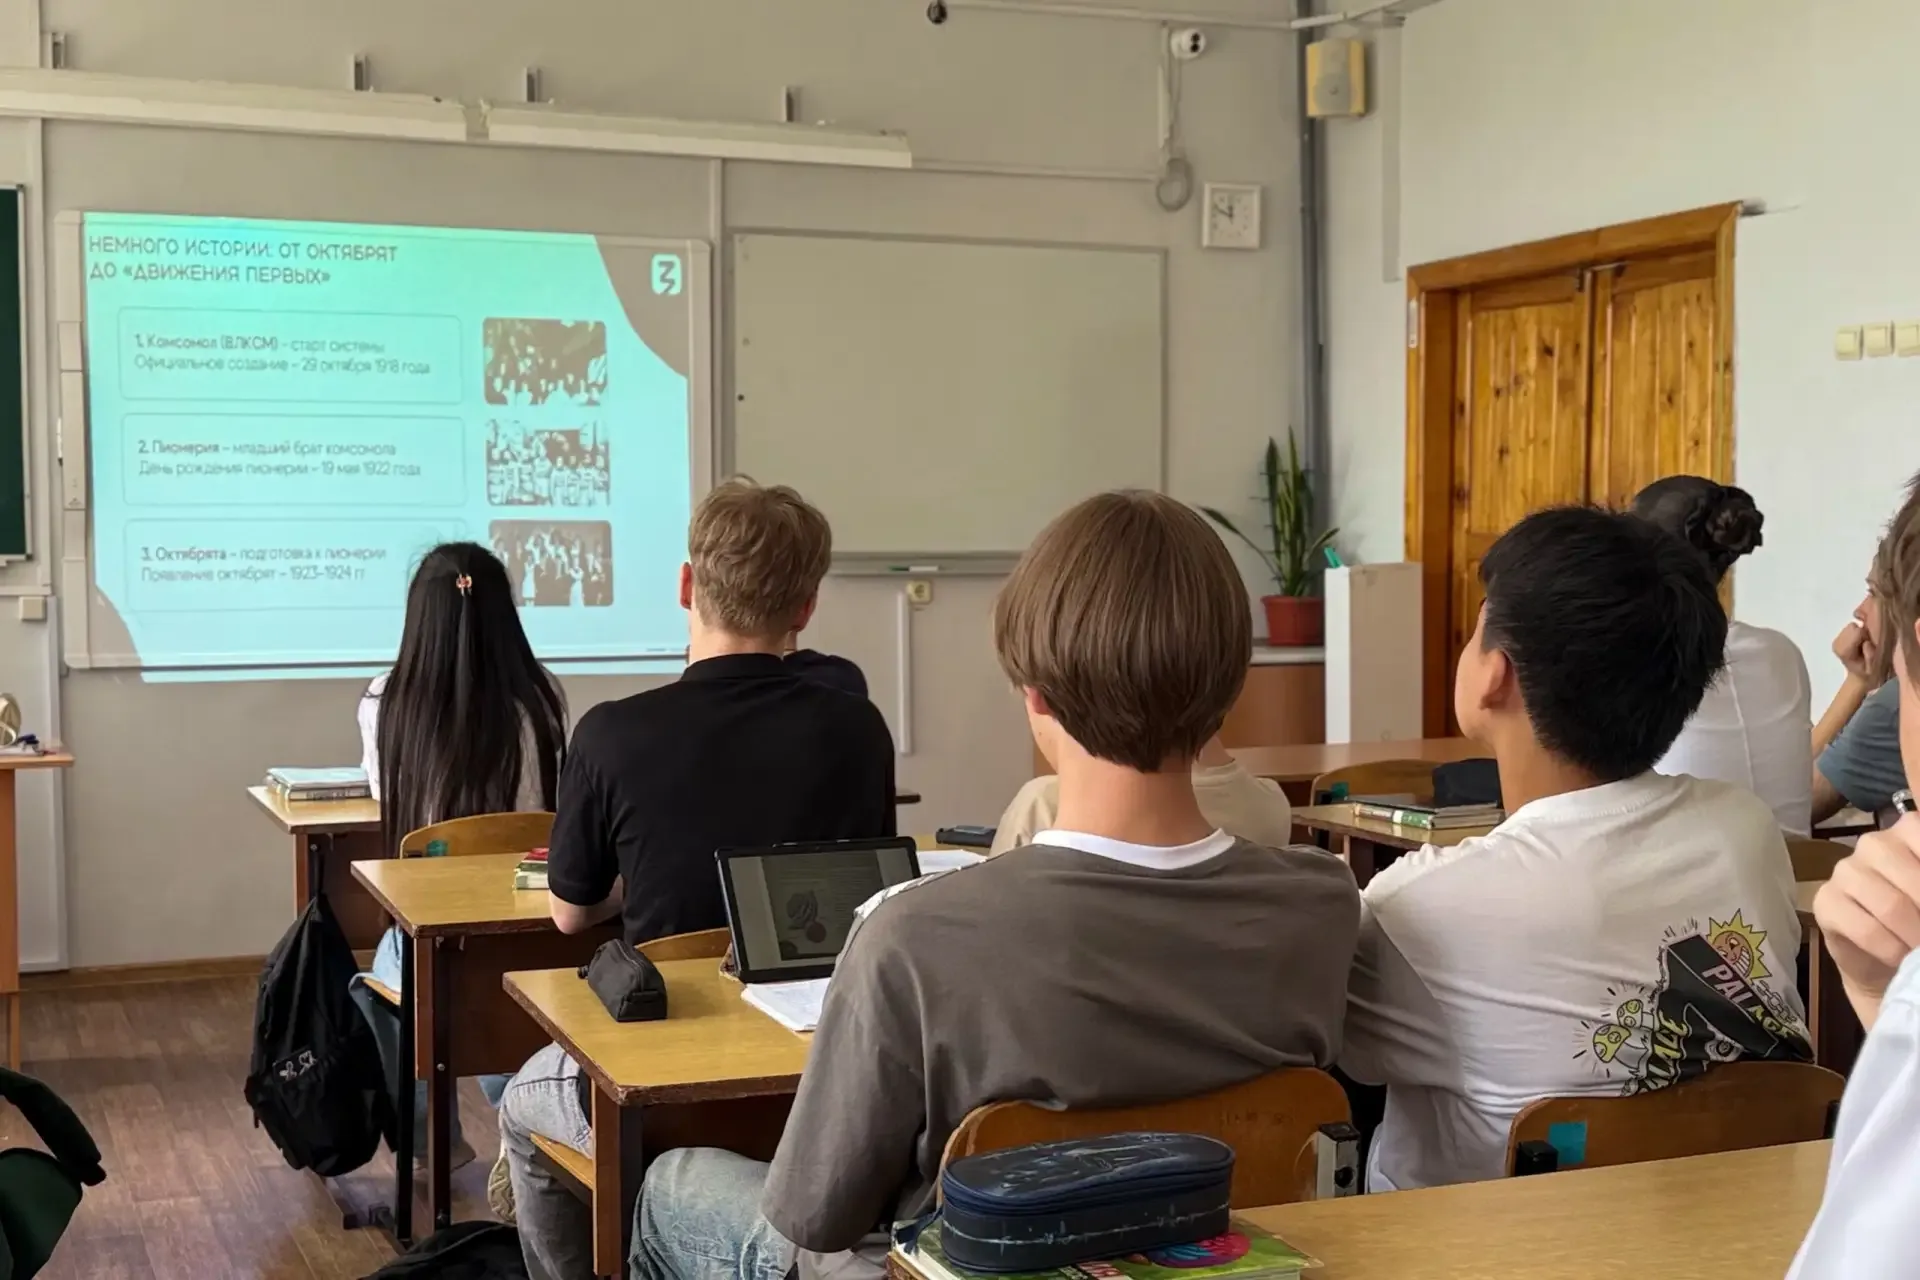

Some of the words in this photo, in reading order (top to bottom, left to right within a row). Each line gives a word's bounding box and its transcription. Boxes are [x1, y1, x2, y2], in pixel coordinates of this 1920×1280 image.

[89, 235, 179, 255] НЕМНОГО
[278, 242, 301, 260] ОТ
[306, 243, 398, 264] ОКТЯБРЯТ
[90, 261, 117, 281] ДО
[123, 262, 240, 282] «ДВИЖЕНИЯ
[245, 265, 331, 285] ПЕРВЫХ»
[146, 333, 218, 349] Комсомол
[220, 334, 278, 351] (ВЛКСМ)
[291, 340, 326, 354] старт
[133, 353, 225, 372] Официальное
[227, 357, 288, 372] создание
[320, 357, 372, 376] октября
[401, 361, 430, 375] года
[151, 439, 220, 457] Пионерия
[293, 440, 324, 458] брат
[326, 444, 396, 456] комсомола
[138, 459, 173, 476] День
[176, 463, 243, 477] рождения
[245, 463, 309, 477] пионерии
[392, 464, 421, 476] года
[155, 545, 226, 564] Октябрята
[324, 547, 387, 562] пионерии
[216, 565, 276, 584] октябрят
